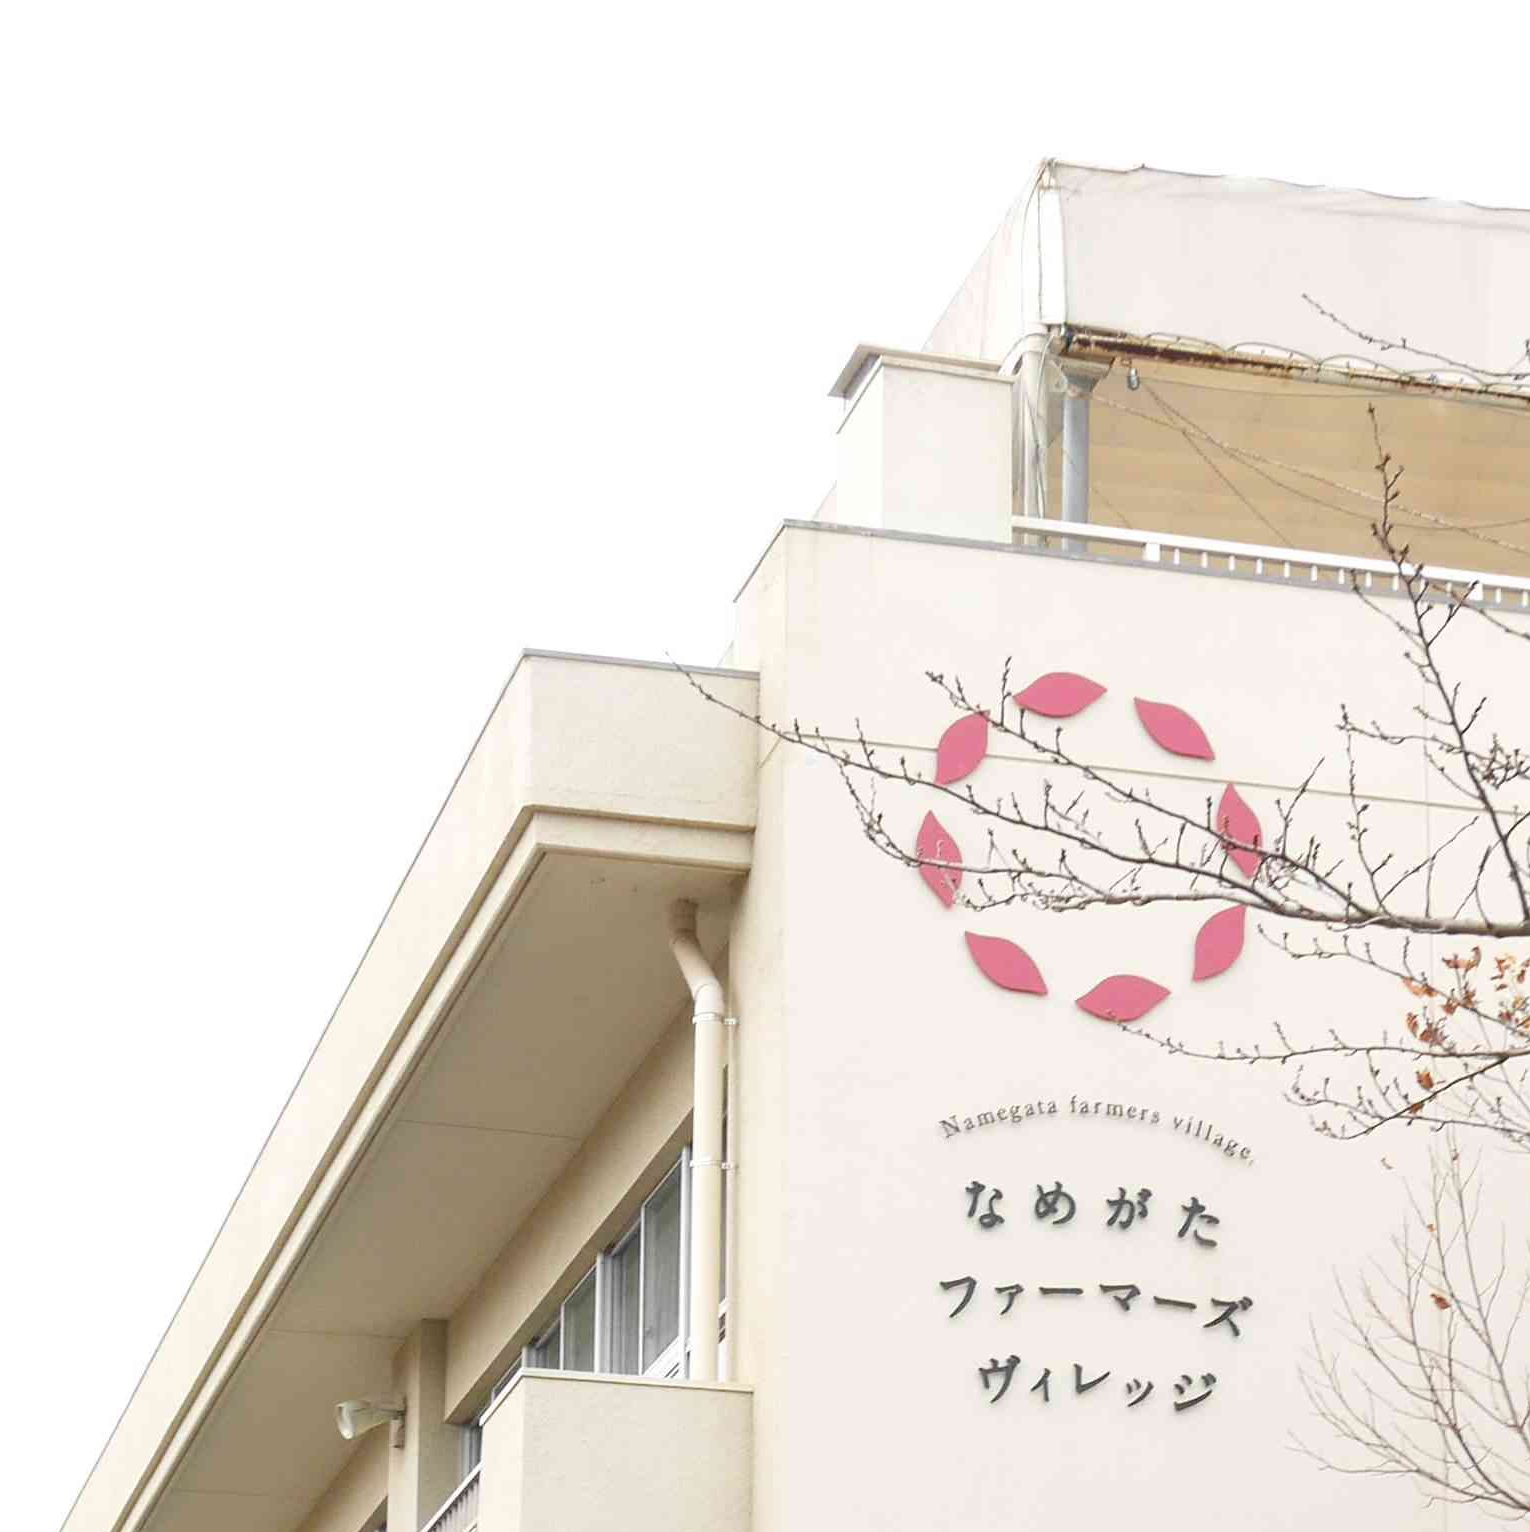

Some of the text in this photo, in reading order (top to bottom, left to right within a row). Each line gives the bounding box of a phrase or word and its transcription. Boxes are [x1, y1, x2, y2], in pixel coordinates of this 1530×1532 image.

[938, 1097, 1058, 1139] Namegata
[1070, 1094, 1161, 1125] farmers
[964, 1180, 1221, 1248] なめがた
[939, 1275, 1254, 1338] ファーマーズ
[977, 1354, 1218, 1412] ヴィレッジ
